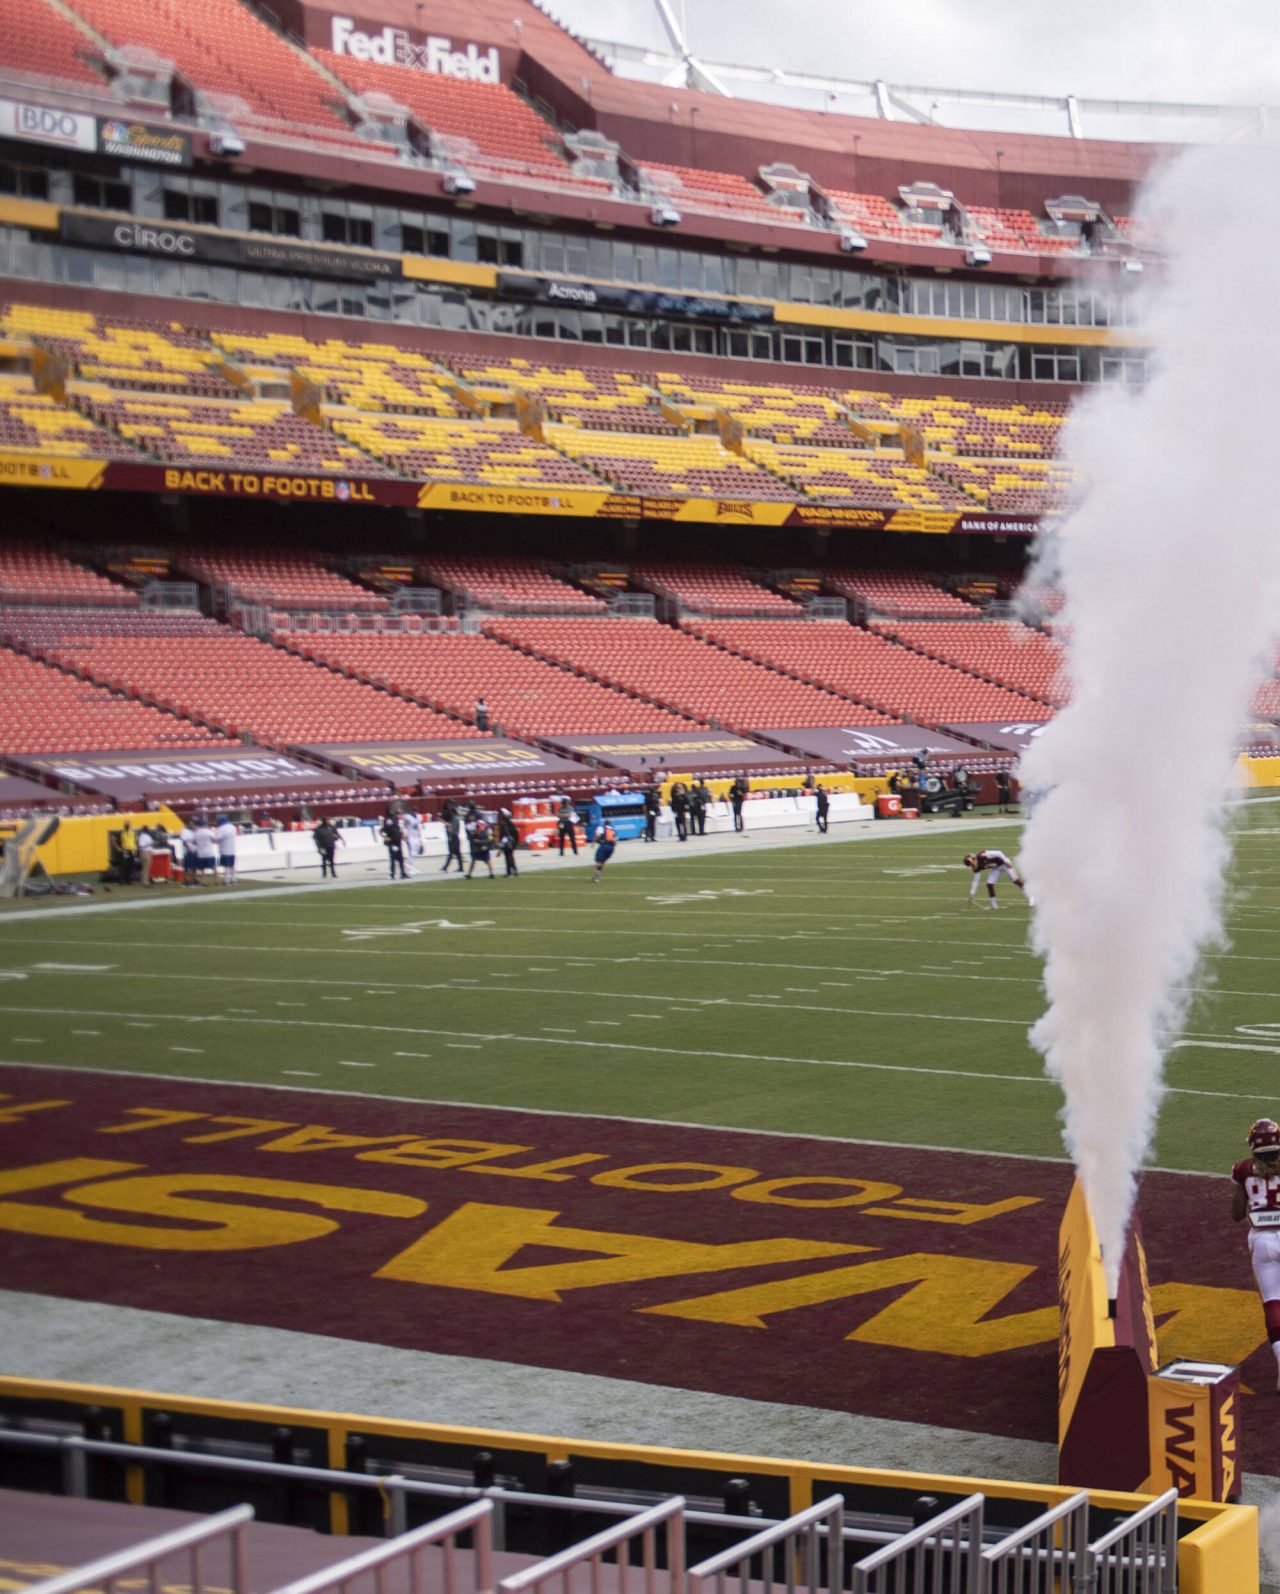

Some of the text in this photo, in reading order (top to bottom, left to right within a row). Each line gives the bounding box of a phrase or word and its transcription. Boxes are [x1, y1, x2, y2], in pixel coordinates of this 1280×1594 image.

[22, 107, 77, 136] BDO
[104, 141, 182, 164] WASHINGTON
[165, 470, 225, 491] BACK
[230, 475, 260, 493] TO
[451, 490, 483, 504] BACK
[487, 493, 504, 505] TO
[797, 507, 884, 522] WASHINGTON
[962, 520, 985, 531] BANK
[987, 521, 998, 531] OF
[999, 522, 1039, 533] AMERICA
[349, 749, 541, 767] AND GOLD
[53, 758, 297, 780] BURGUNDY
[371, 764, 429, 773] FIRST
